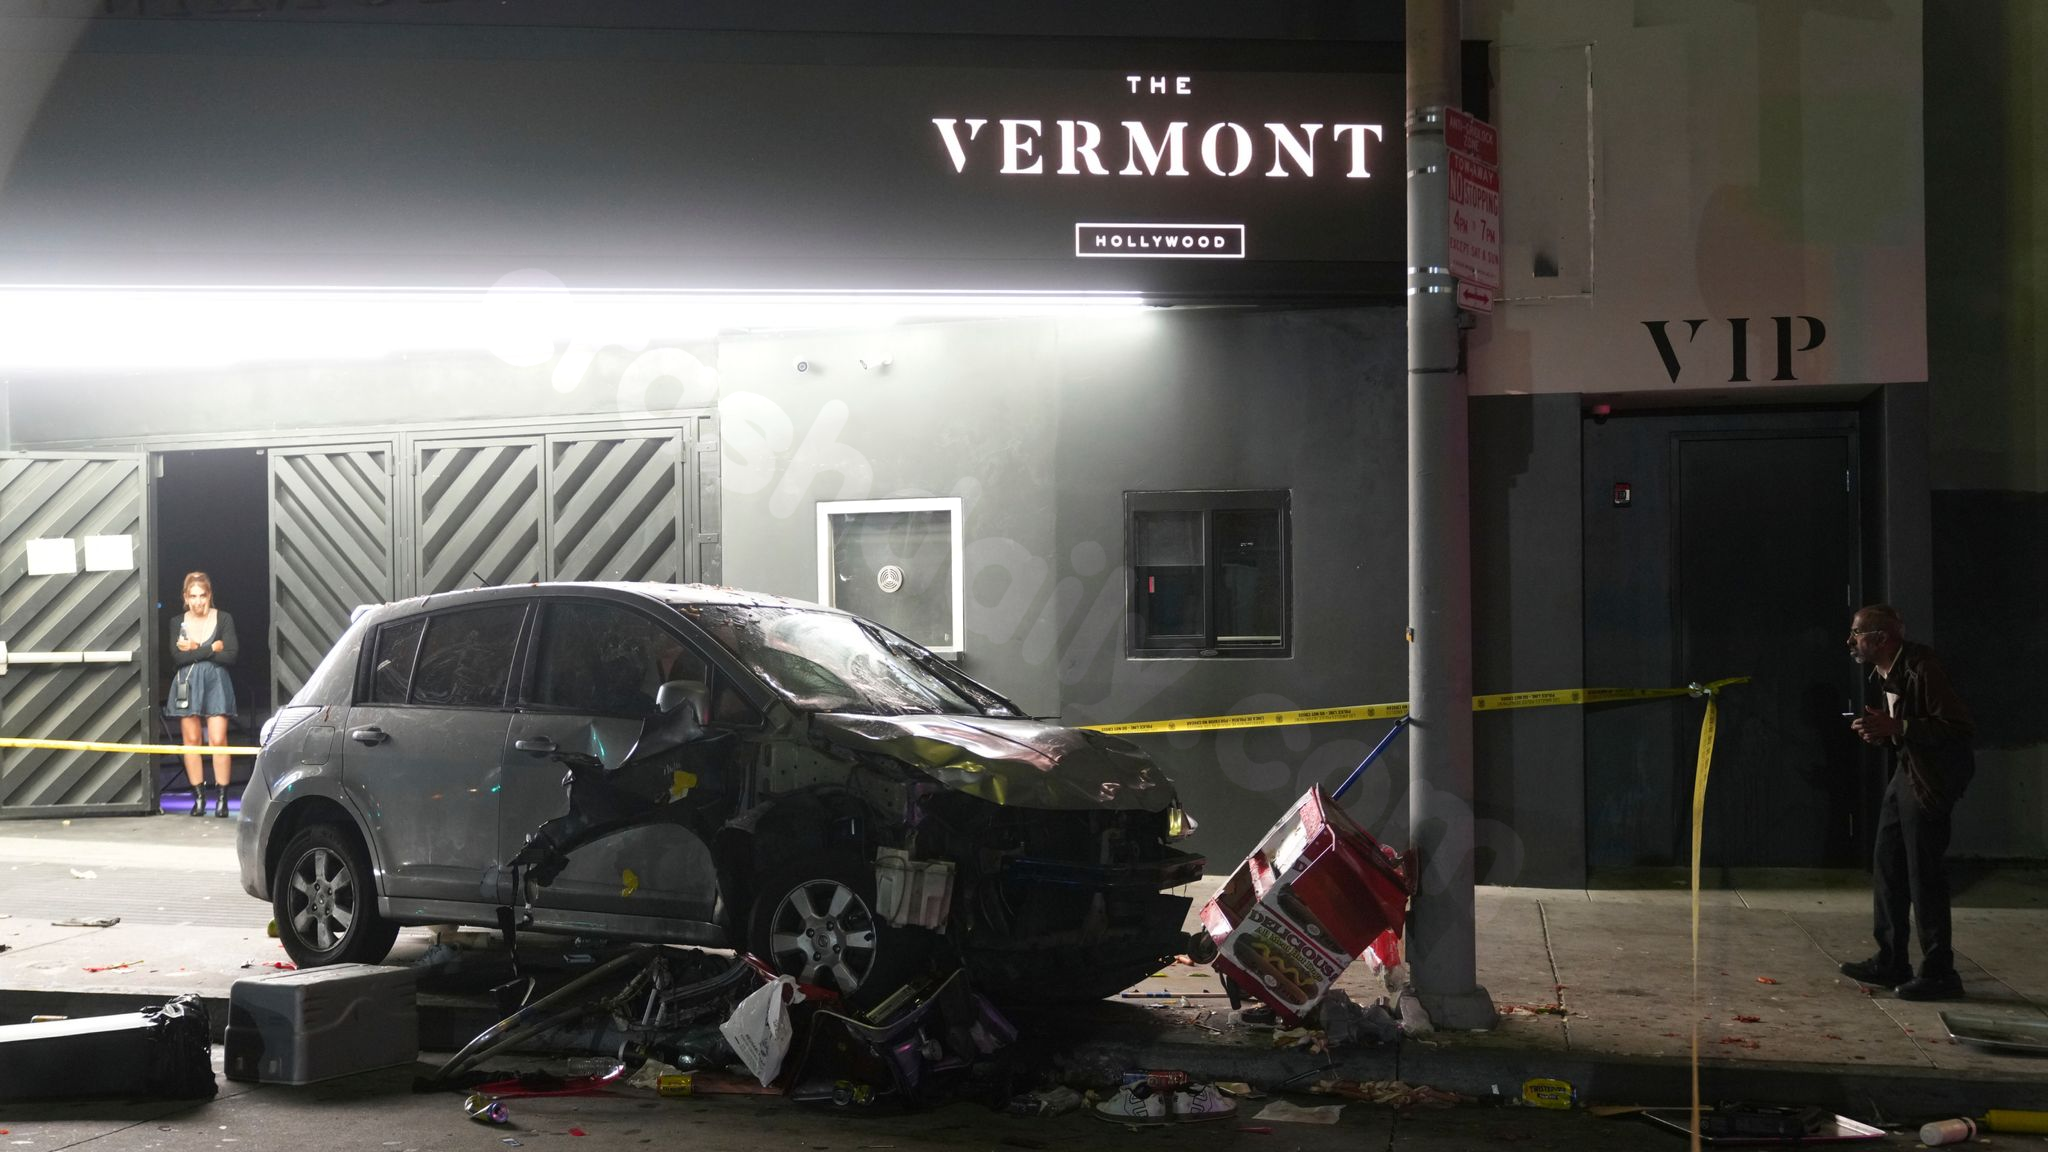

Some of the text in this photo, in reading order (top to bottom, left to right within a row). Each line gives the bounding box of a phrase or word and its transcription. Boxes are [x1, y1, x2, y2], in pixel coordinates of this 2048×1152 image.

[1127, 76, 1192, 94] THE
[931, 118, 1383, 179] VERMONT
[1454, 155, 1494, 184] TOW-AWAY
[1450, 168, 1498, 217] NO STOPPING
[1096, 235, 1226, 249] HOLLYWOOD
[1641, 316, 1827, 384] VIP
[1248, 909, 1340, 982] DELICIOUS!
